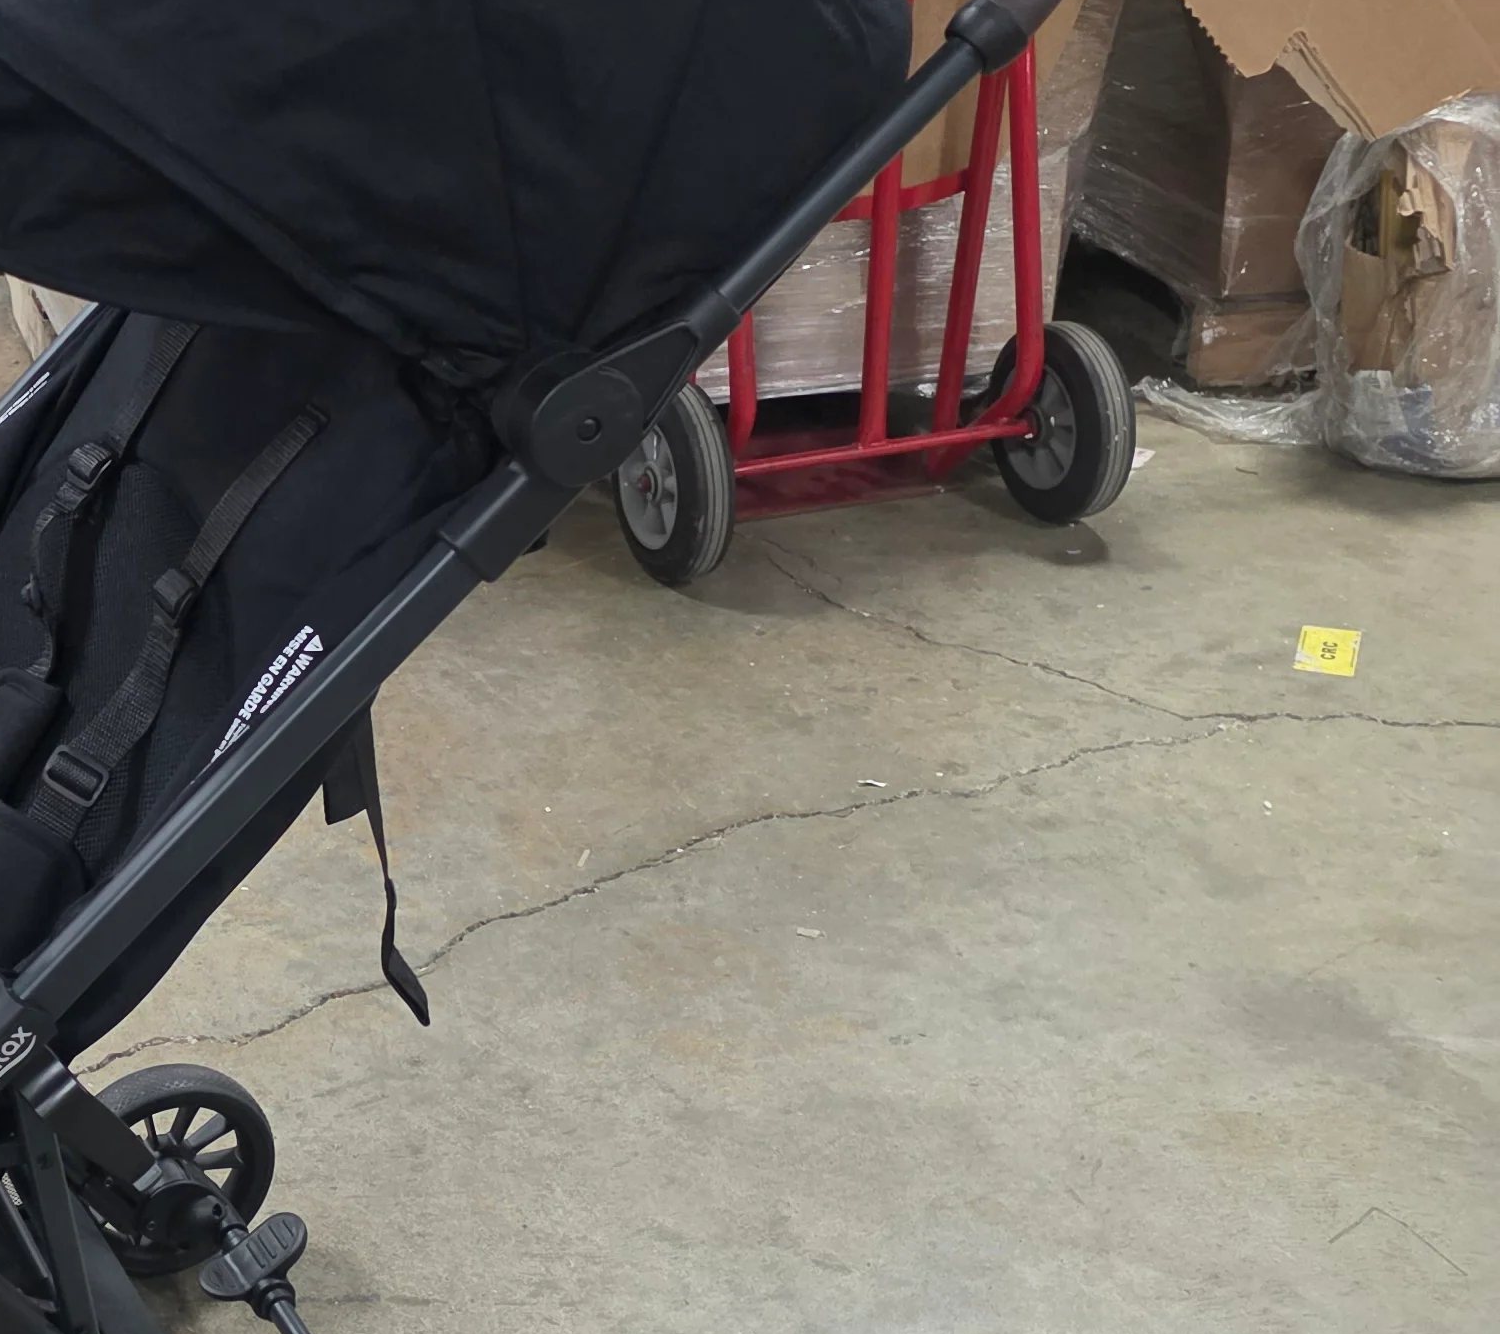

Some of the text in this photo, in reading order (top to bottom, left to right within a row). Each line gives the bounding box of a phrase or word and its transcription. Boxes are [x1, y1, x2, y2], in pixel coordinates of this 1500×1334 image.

[238, 625, 314, 721] MISE EN GARDE
[1320, 641, 1338, 660] CRC
